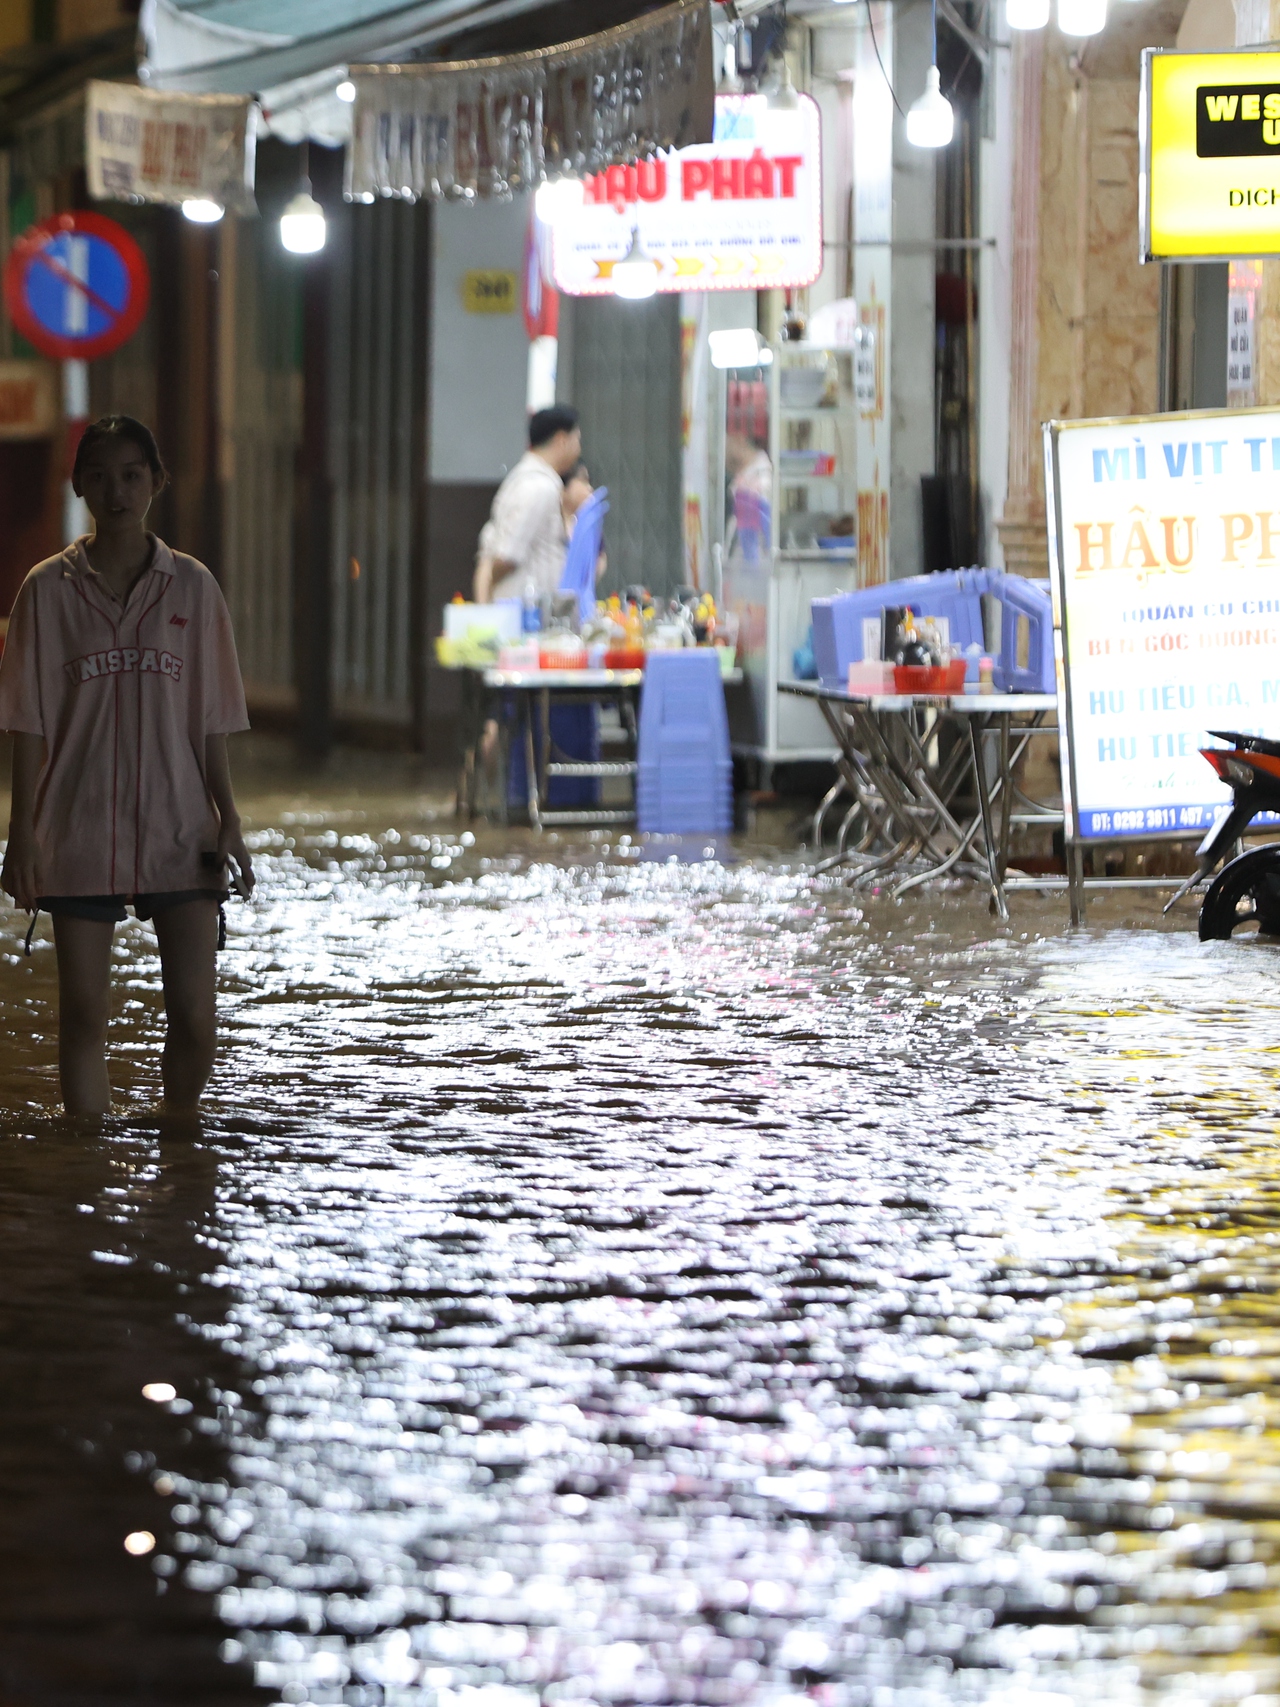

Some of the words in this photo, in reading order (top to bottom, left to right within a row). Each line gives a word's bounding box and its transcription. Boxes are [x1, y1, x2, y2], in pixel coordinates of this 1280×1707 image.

[682, 146, 803, 201] PHÁT
[1092, 436, 1146, 483] MÌ
[1162, 440, 1228, 485] VỊT
[1073, 503, 1197, 583] HẬU
[62, 647, 183, 687] UNISPACE
